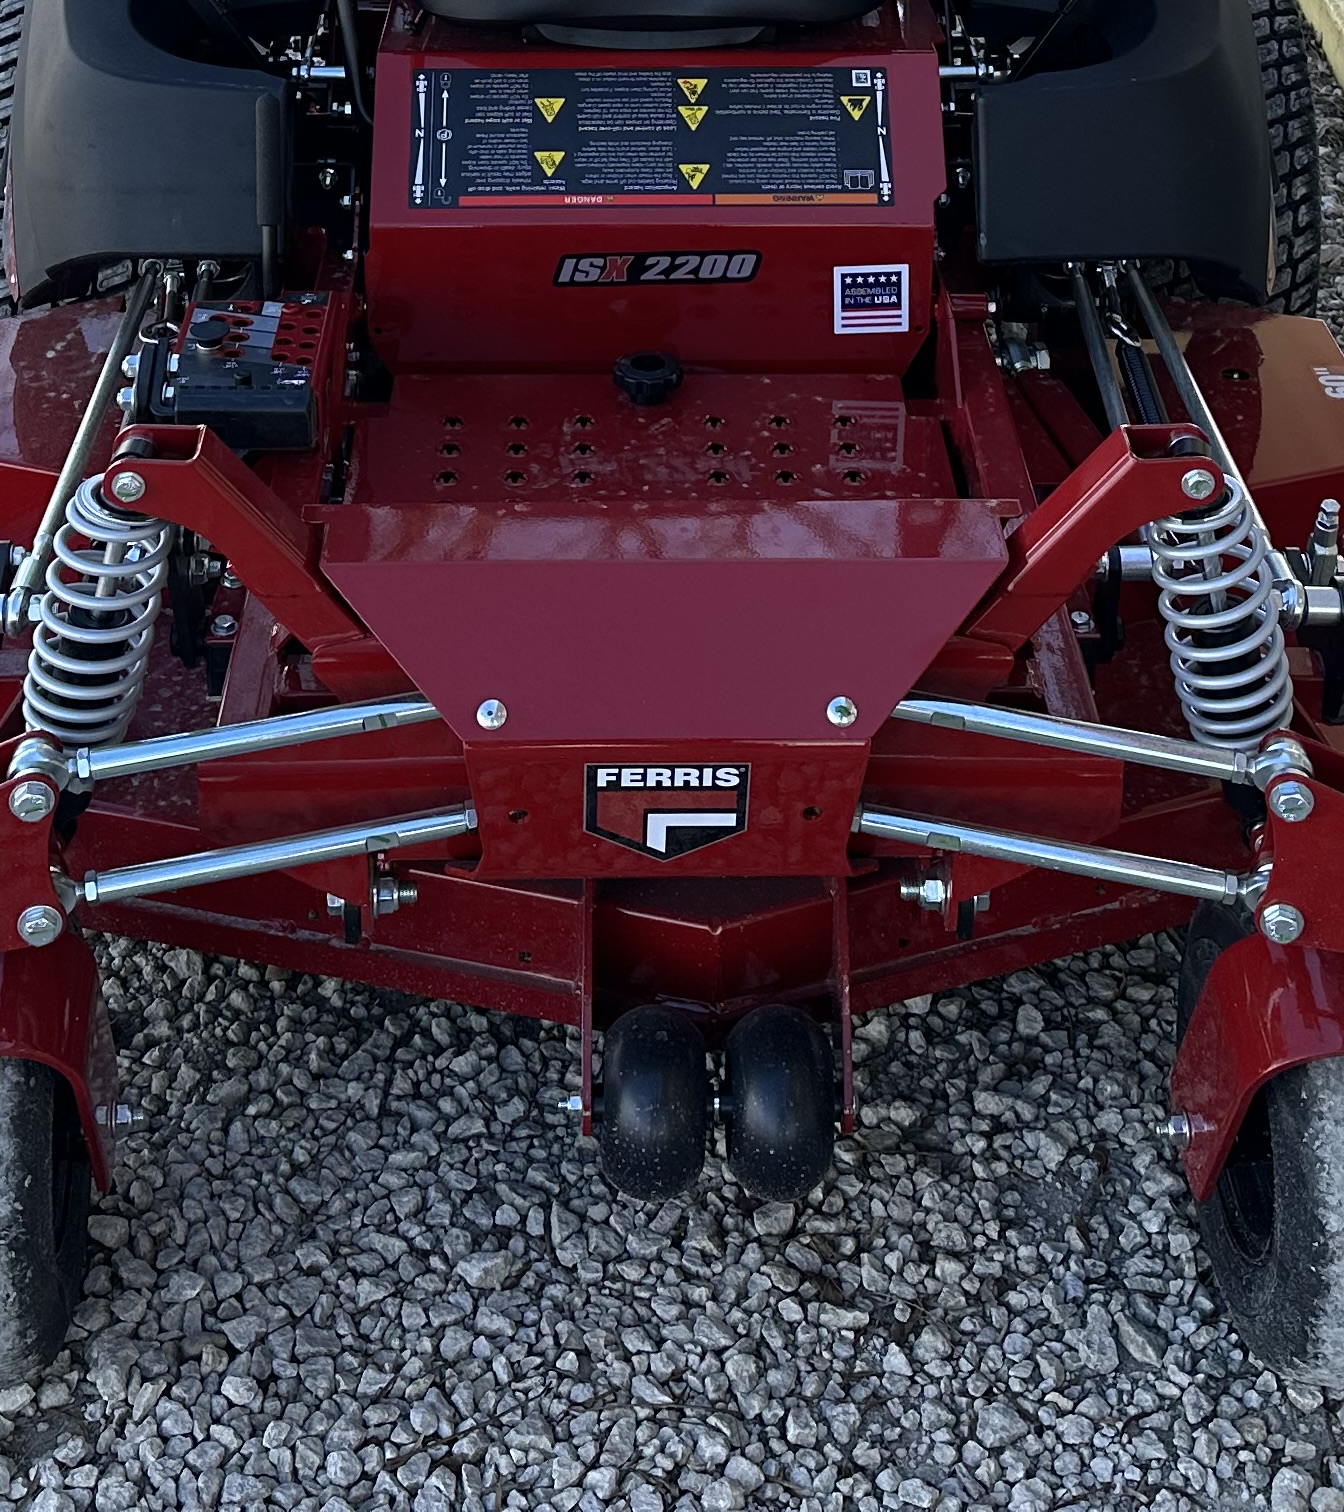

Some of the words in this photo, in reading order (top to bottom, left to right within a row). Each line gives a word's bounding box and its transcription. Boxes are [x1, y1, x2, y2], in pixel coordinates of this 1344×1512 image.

[415, 128, 425, 138] N
[877, 126, 887, 136] N
[564, 196, 603, 204] DANGER
[558, 255, 635, 283] ISX
[640, 254, 757, 281] 2200
[844, 287, 898, 297] ASSEMBLED
[844, 296, 854, 305] IN
[856, 296, 872, 305] THE
[874, 295, 898, 304] USA
[596, 767, 741, 788] FERRIS
